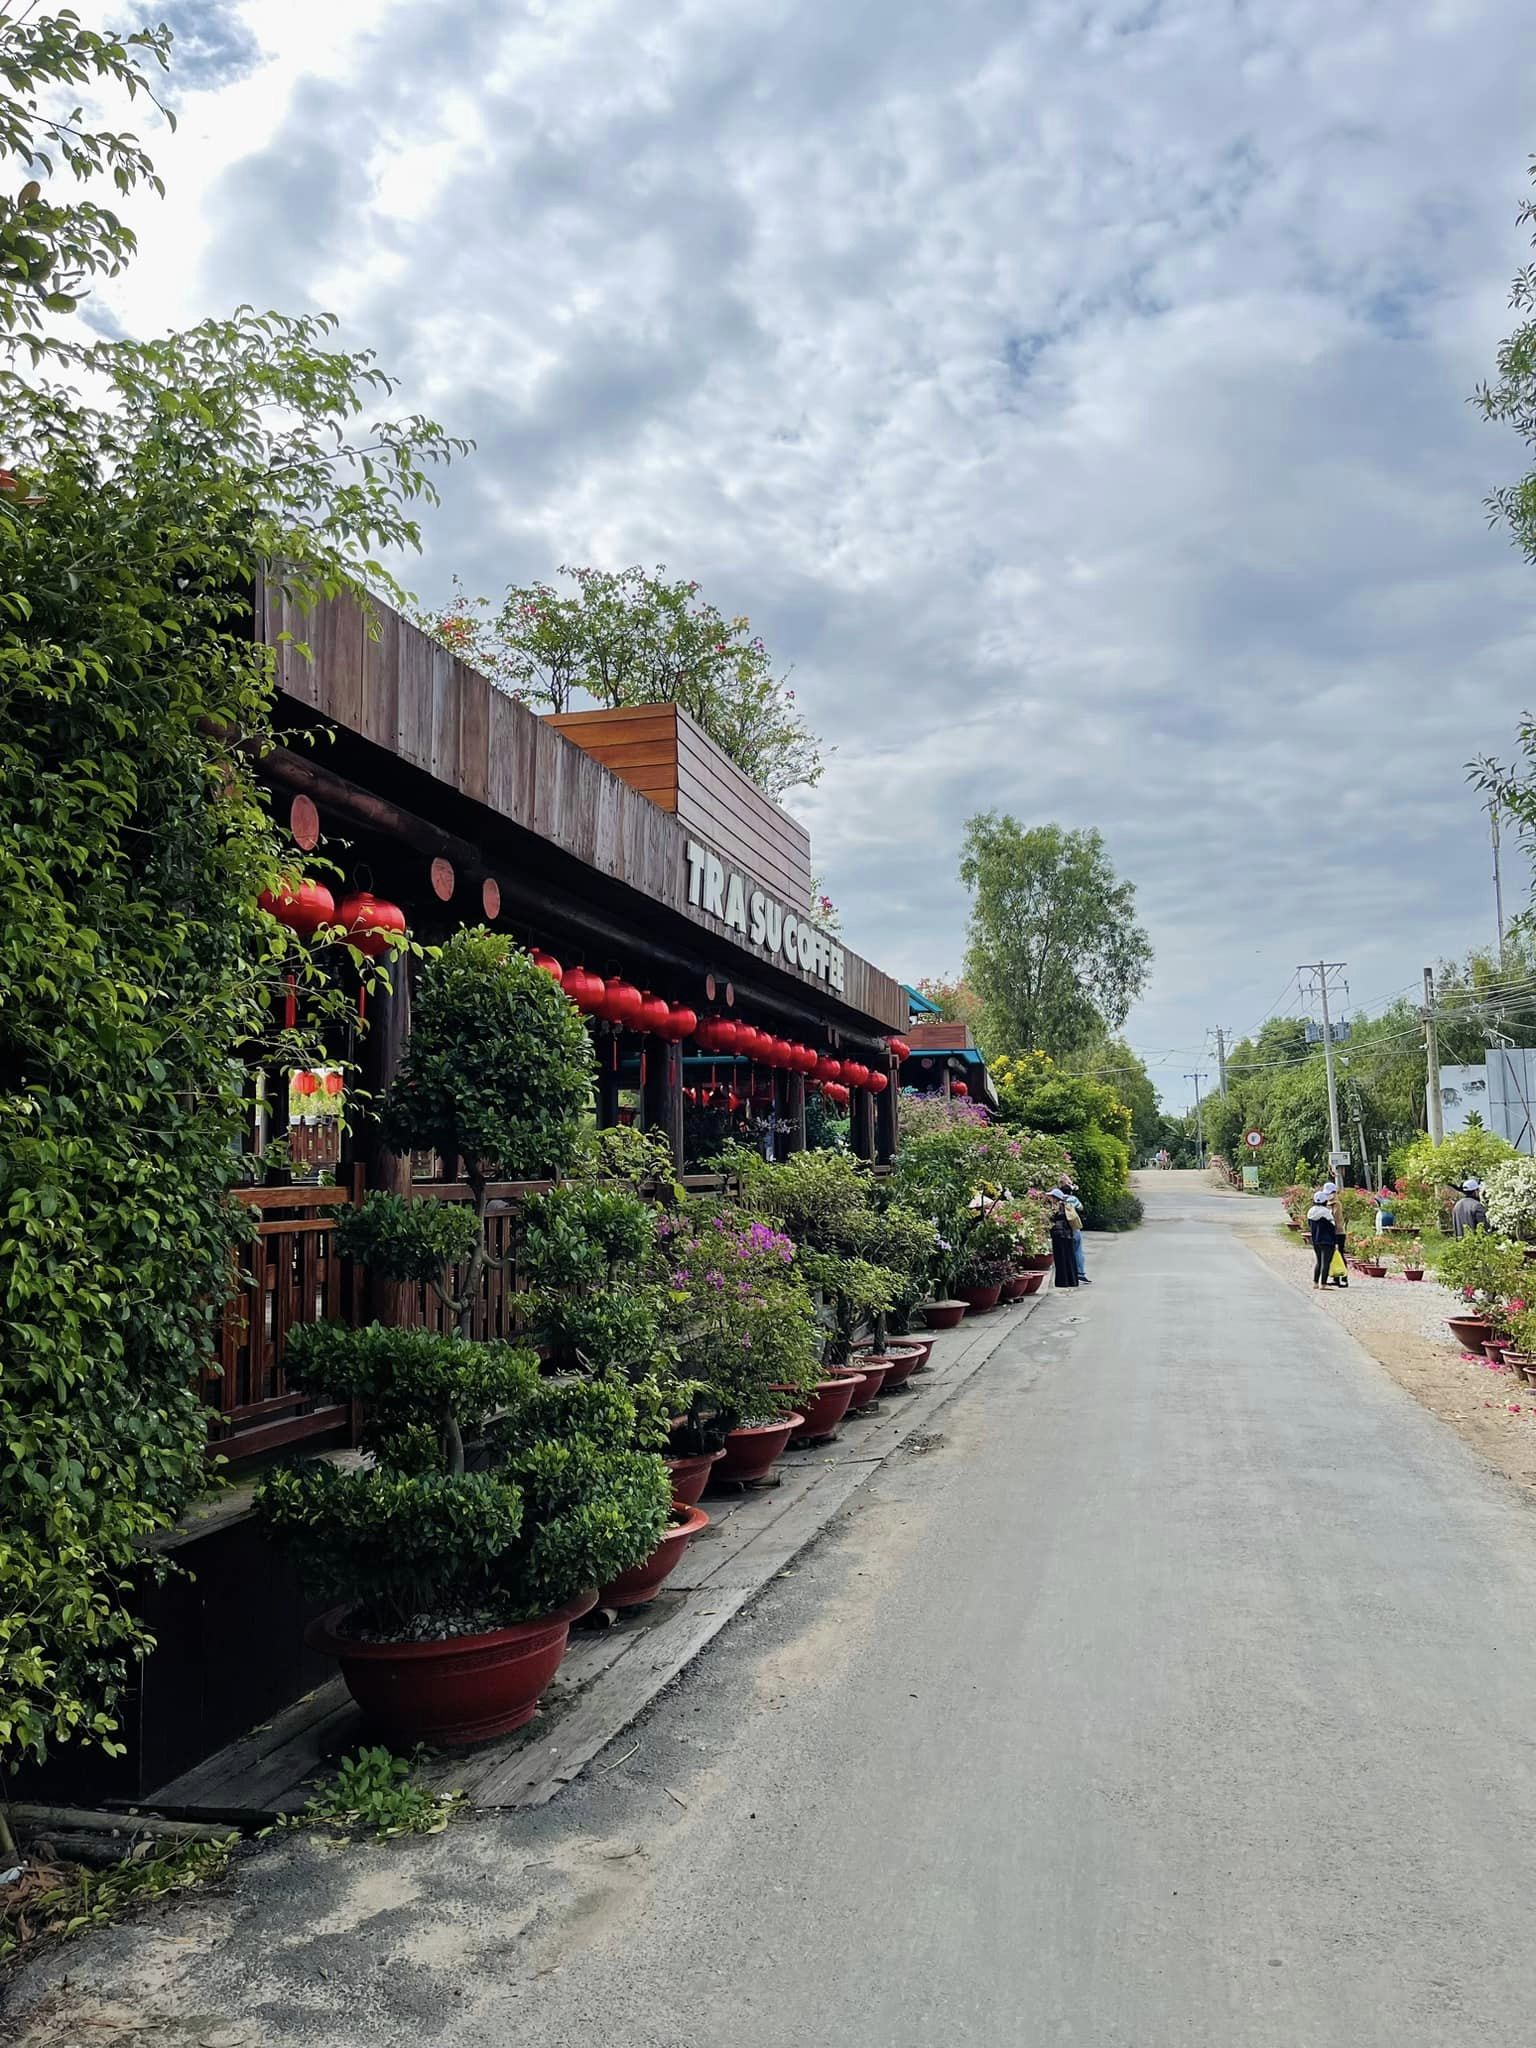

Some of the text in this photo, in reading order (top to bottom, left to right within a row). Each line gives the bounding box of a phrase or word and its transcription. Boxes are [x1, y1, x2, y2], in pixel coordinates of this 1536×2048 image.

[687, 840, 844, 992] TRA SU COFFEE
